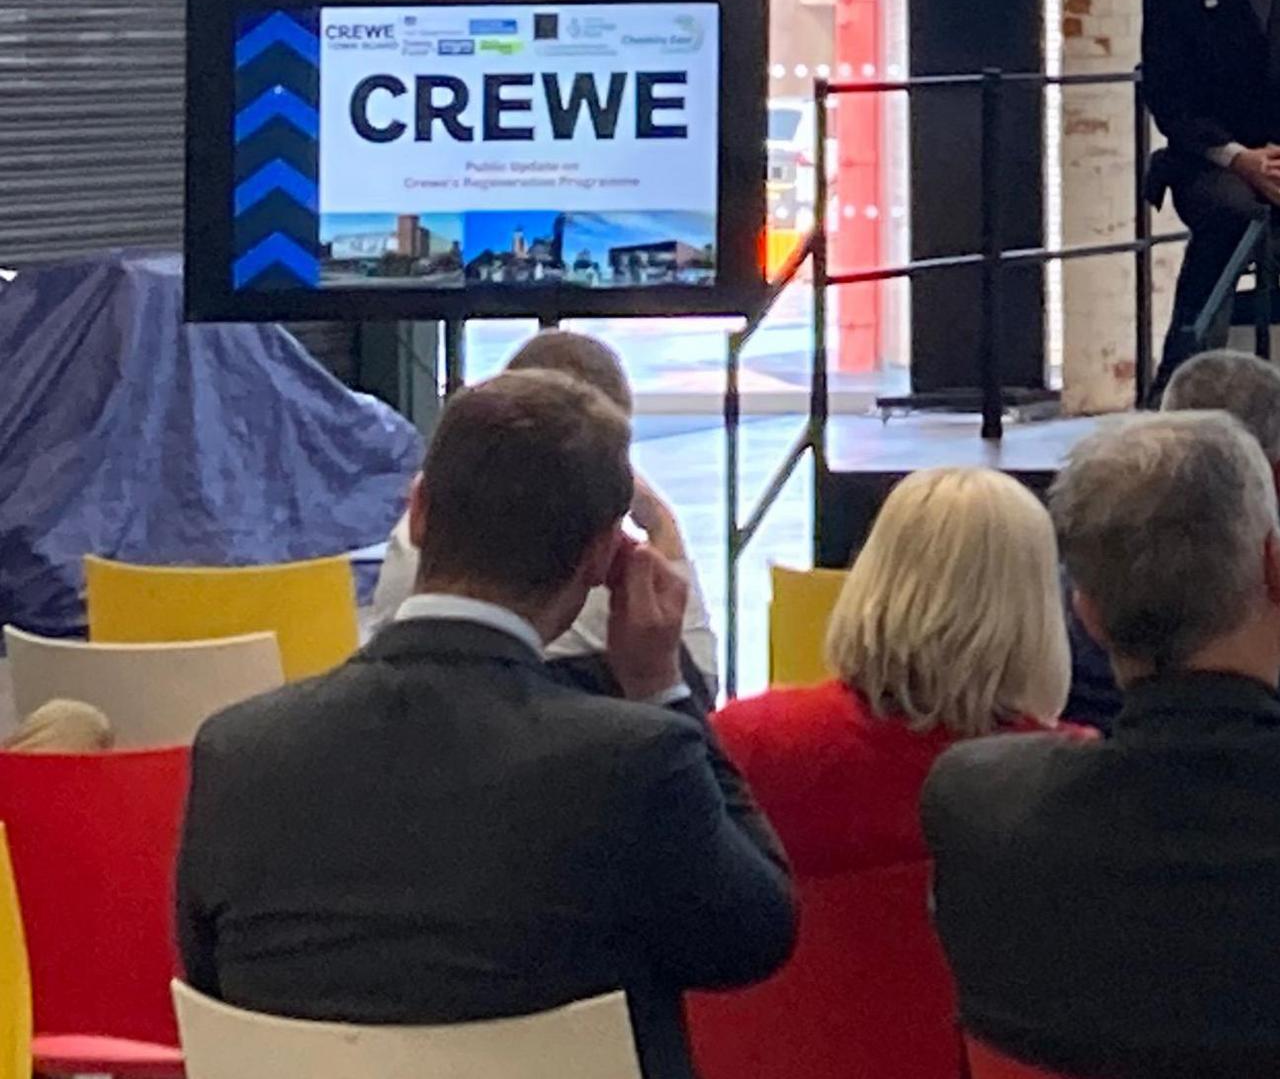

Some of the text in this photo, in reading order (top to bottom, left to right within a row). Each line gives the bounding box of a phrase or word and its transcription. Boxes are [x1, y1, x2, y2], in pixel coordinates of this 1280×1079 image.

[326, 24, 394, 39] CREWE
[349, 70, 688, 143] CREWE
[465, 160, 580, 173] Public Update on
[403, 177, 640, 190] Crewe's Regeneration Programme
